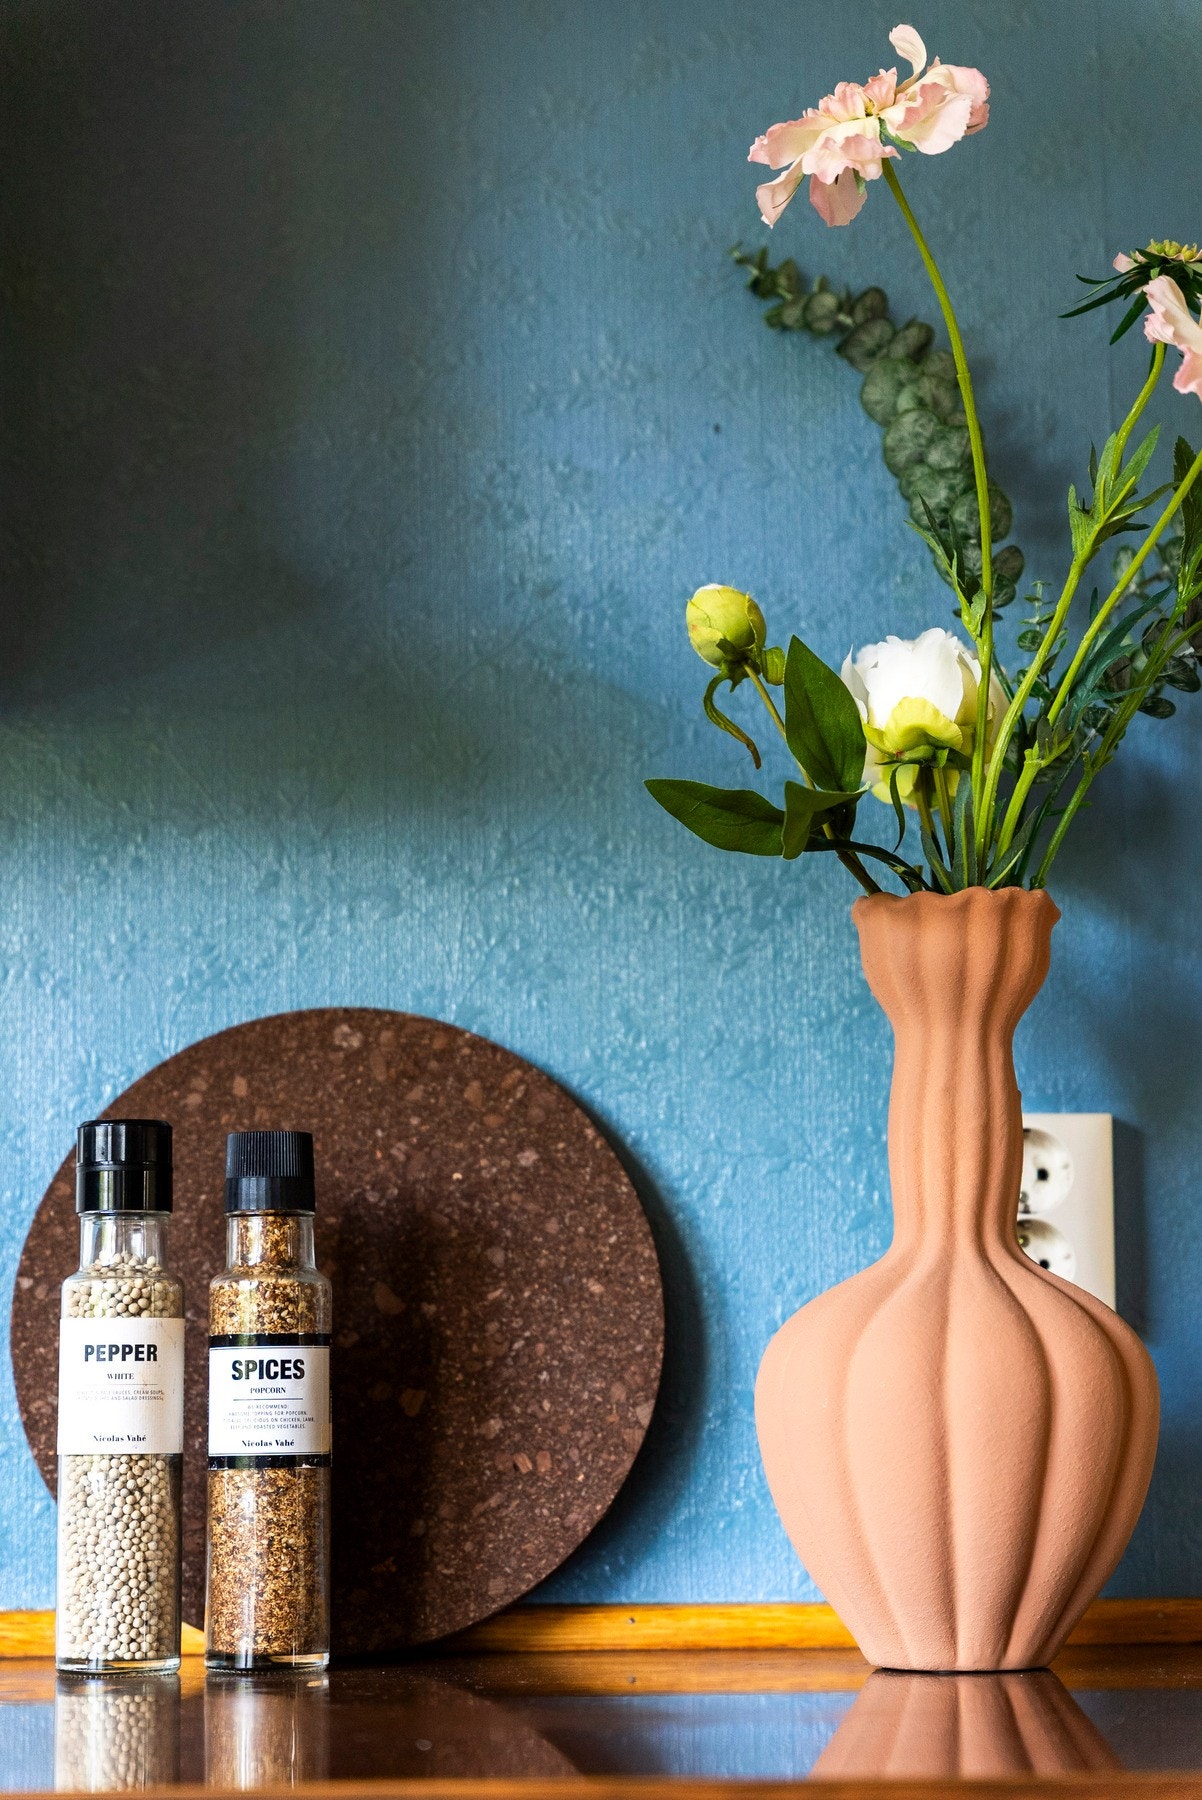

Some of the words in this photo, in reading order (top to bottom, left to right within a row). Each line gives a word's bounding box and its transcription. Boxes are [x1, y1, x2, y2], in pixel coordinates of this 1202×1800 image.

[84, 1344, 158, 1362] PEPPER
[231, 1359, 305, 1380] SPICES
[93, 1434, 124, 1442] Nicolas
[126, 1434, 147, 1442] Vahé
[275, 1439, 295, 1447] Vahé
